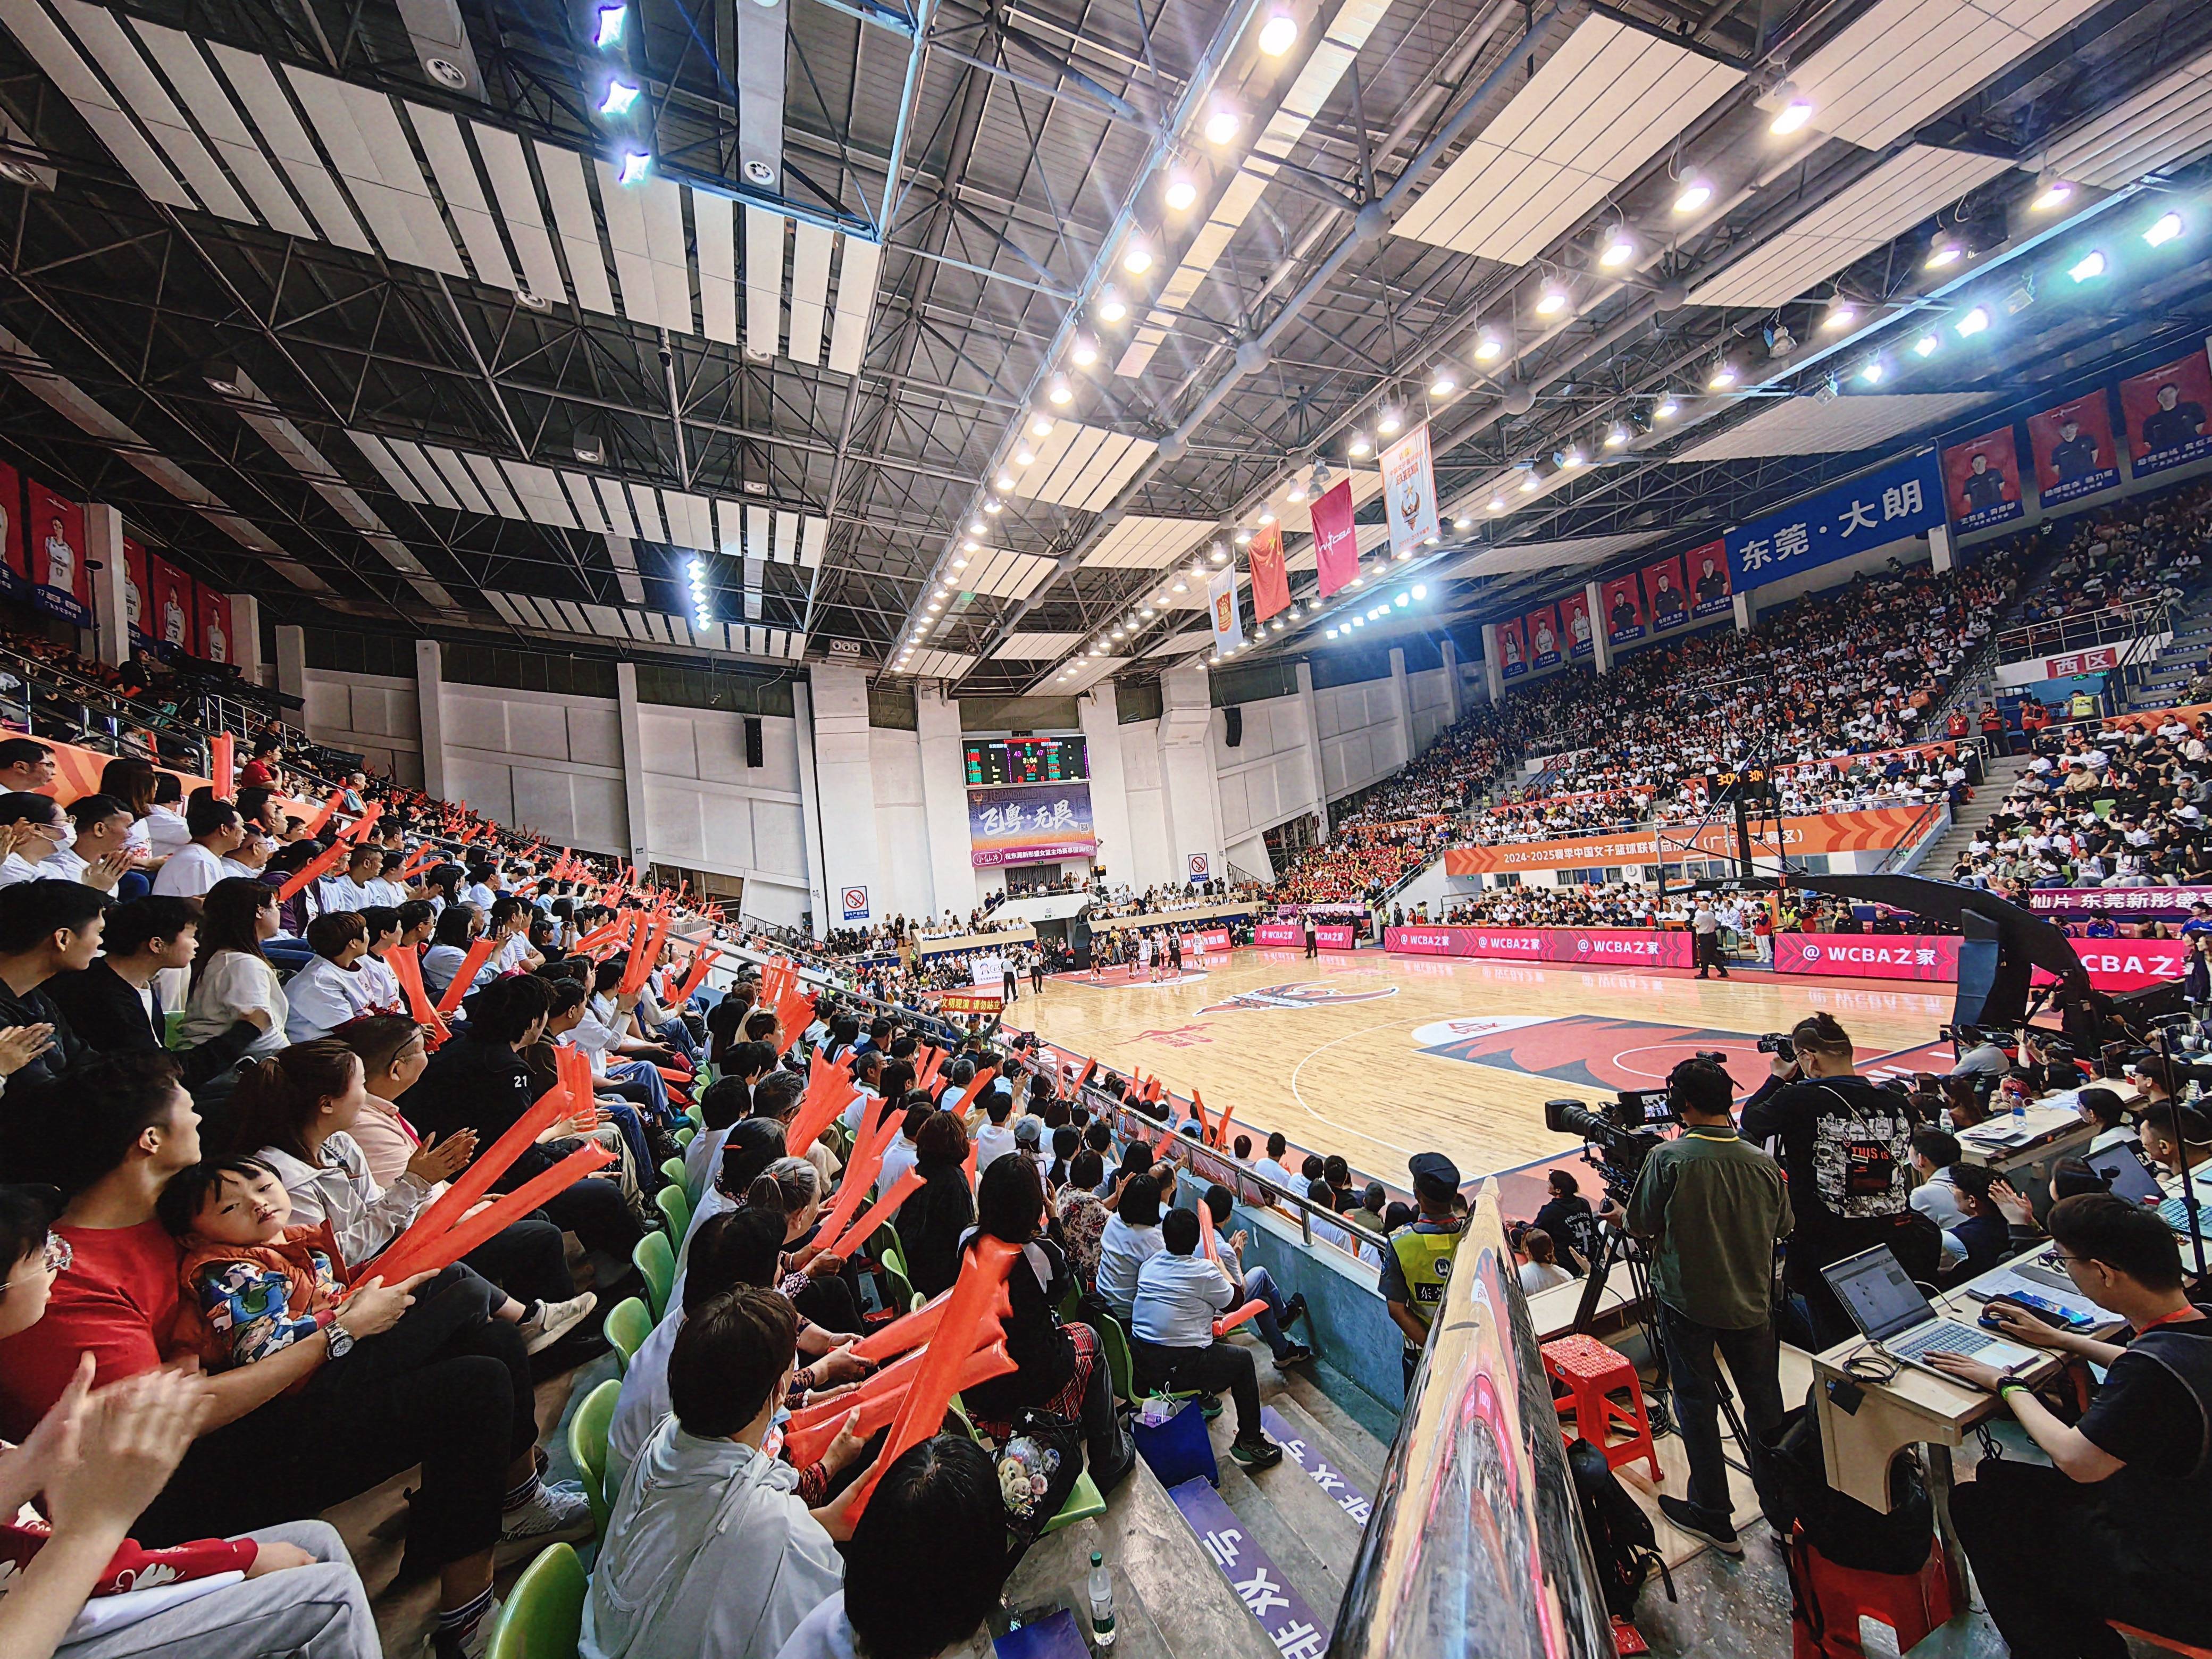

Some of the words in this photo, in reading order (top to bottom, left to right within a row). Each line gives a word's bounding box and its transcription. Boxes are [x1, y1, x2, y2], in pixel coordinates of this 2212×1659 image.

[1739, 480, 1923, 572] 东莞·大朗
[2054, 651, 2112, 675] 西区
[1748, 770, 1764, 782] 3:04
[1401, 934, 1408, 945] @
[1410, 935, 1449, 946] WCBA之家
[1478, 937, 1487, 949] @
[1490, 937, 1540, 950] WCBA之家
[1578, 940, 1589, 952] @
[1593, 940, 1659, 954] WCBA之家
[1802, 944, 1821, 961] @
[1827, 946, 1936, 966] WCBA之家
[514, 1075, 527, 1087] 21
